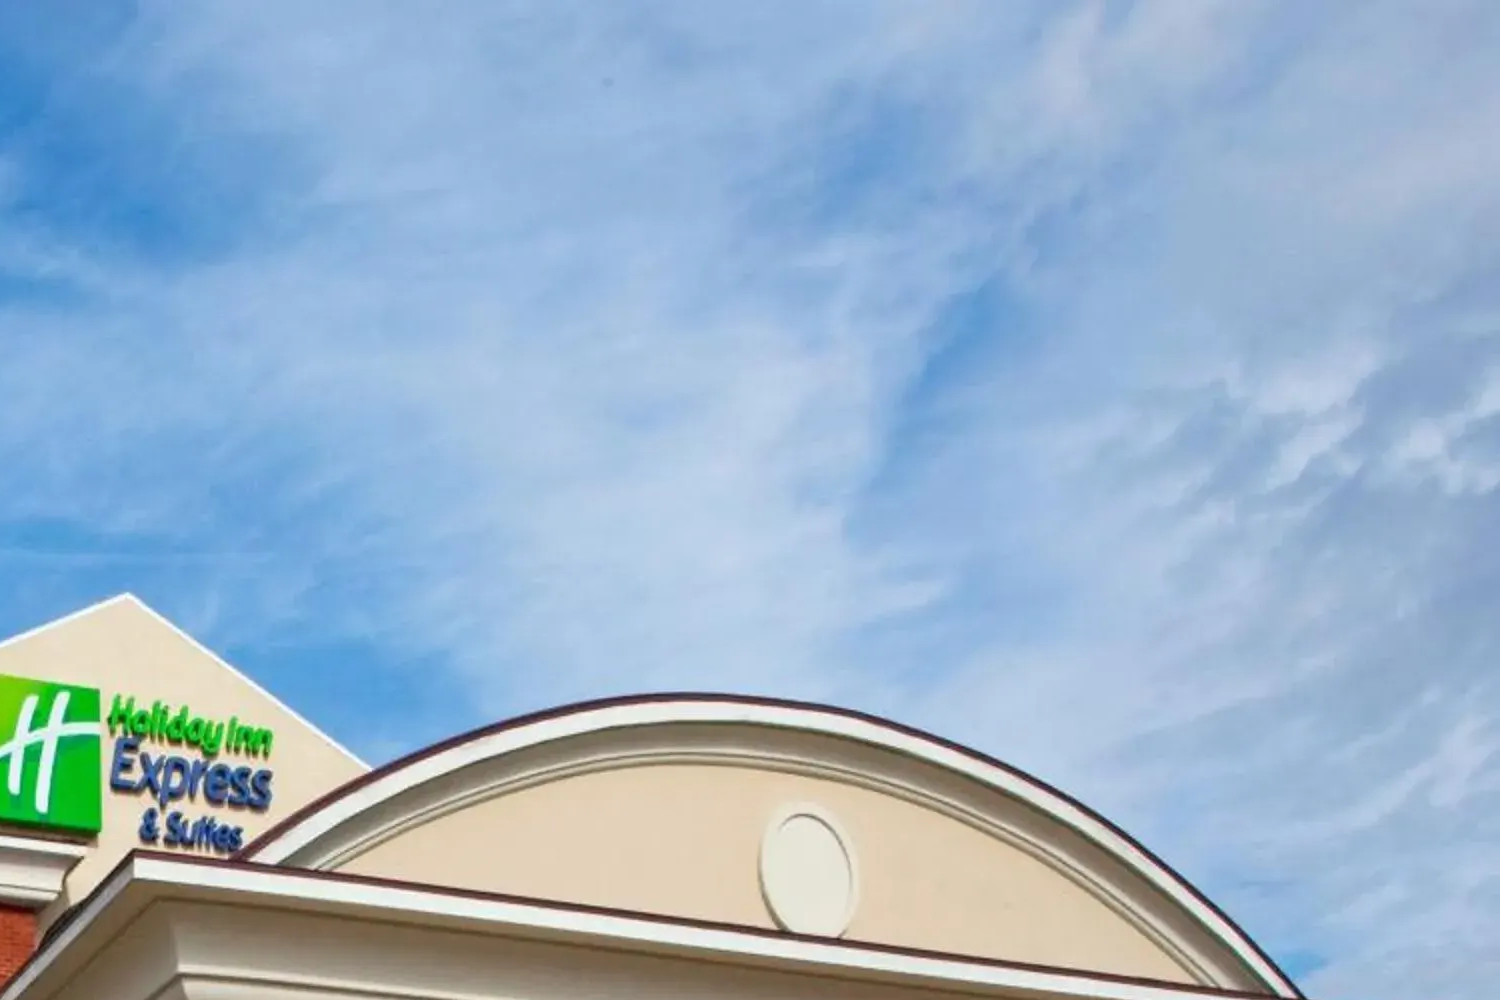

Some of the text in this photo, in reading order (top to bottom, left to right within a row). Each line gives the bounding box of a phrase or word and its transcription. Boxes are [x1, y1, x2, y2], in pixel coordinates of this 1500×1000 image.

[107, 693, 274, 759] Holiday Inn
[110, 736, 273, 812] Express
[139, 807, 244, 852] & Suites
